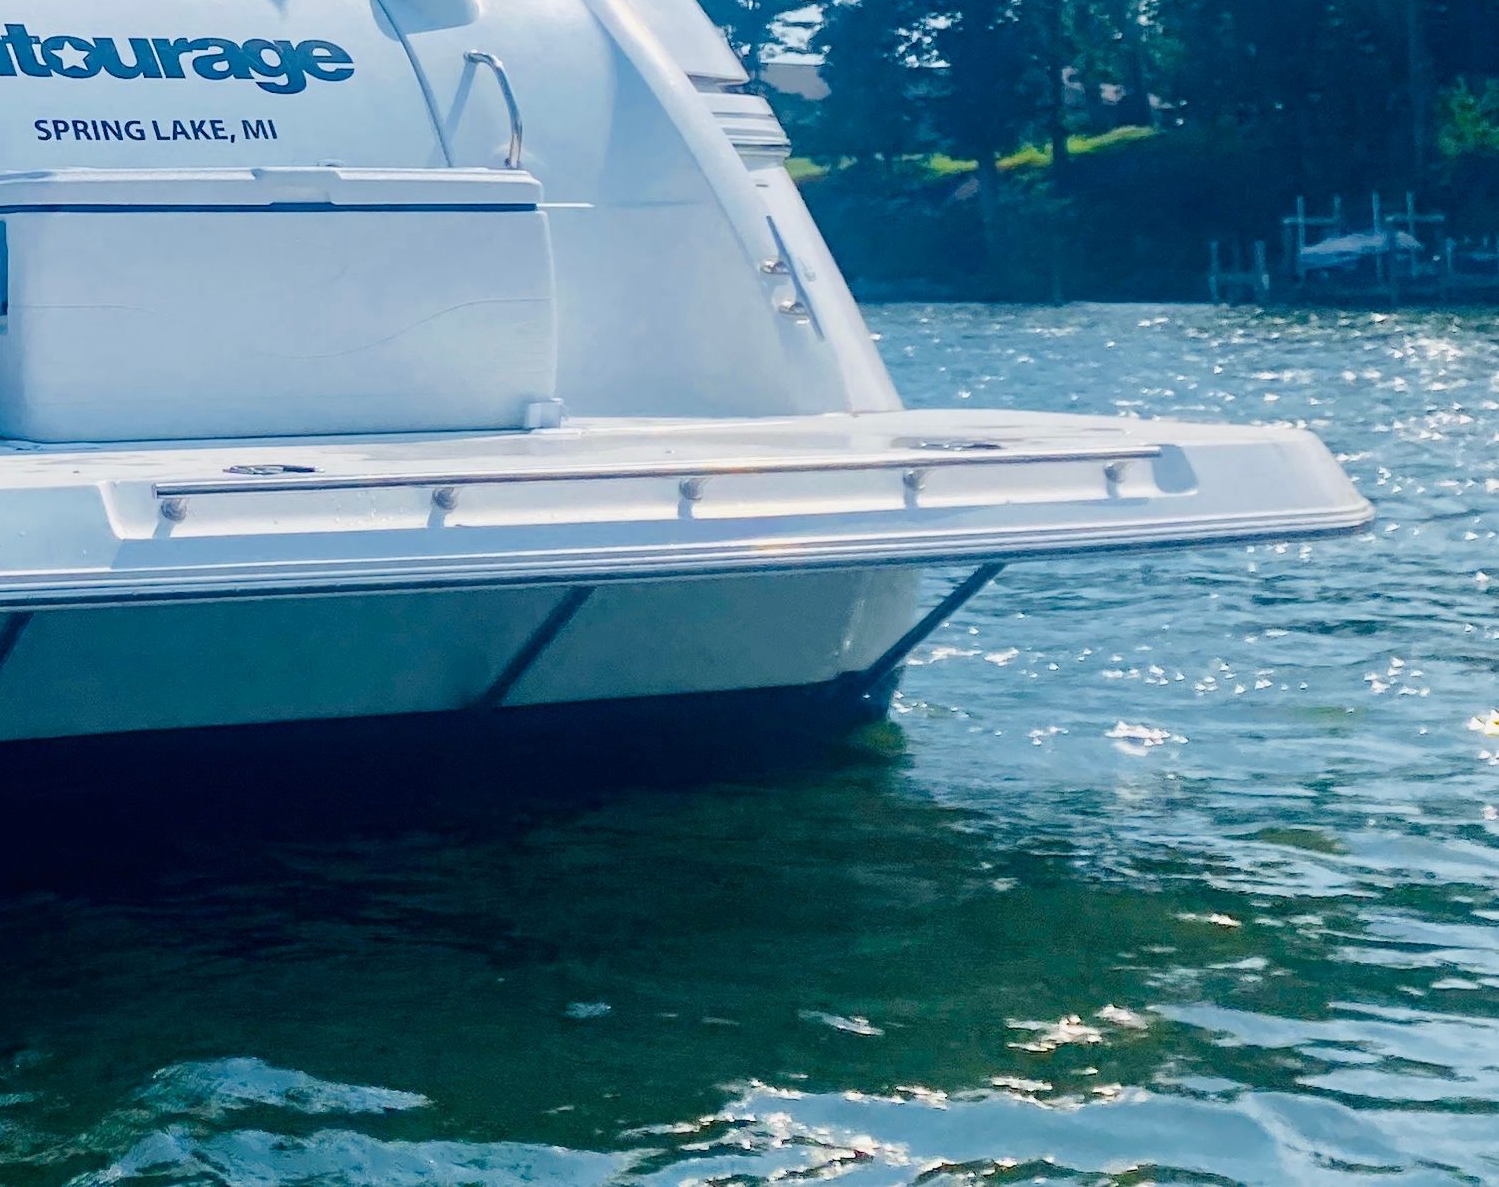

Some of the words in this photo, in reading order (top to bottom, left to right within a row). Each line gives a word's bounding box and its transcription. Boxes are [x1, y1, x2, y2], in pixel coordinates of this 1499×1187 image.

[34, 119, 146, 141] SPRING
[152, 119, 236, 144] LAKE,
[242, 120, 278, 140] MI
